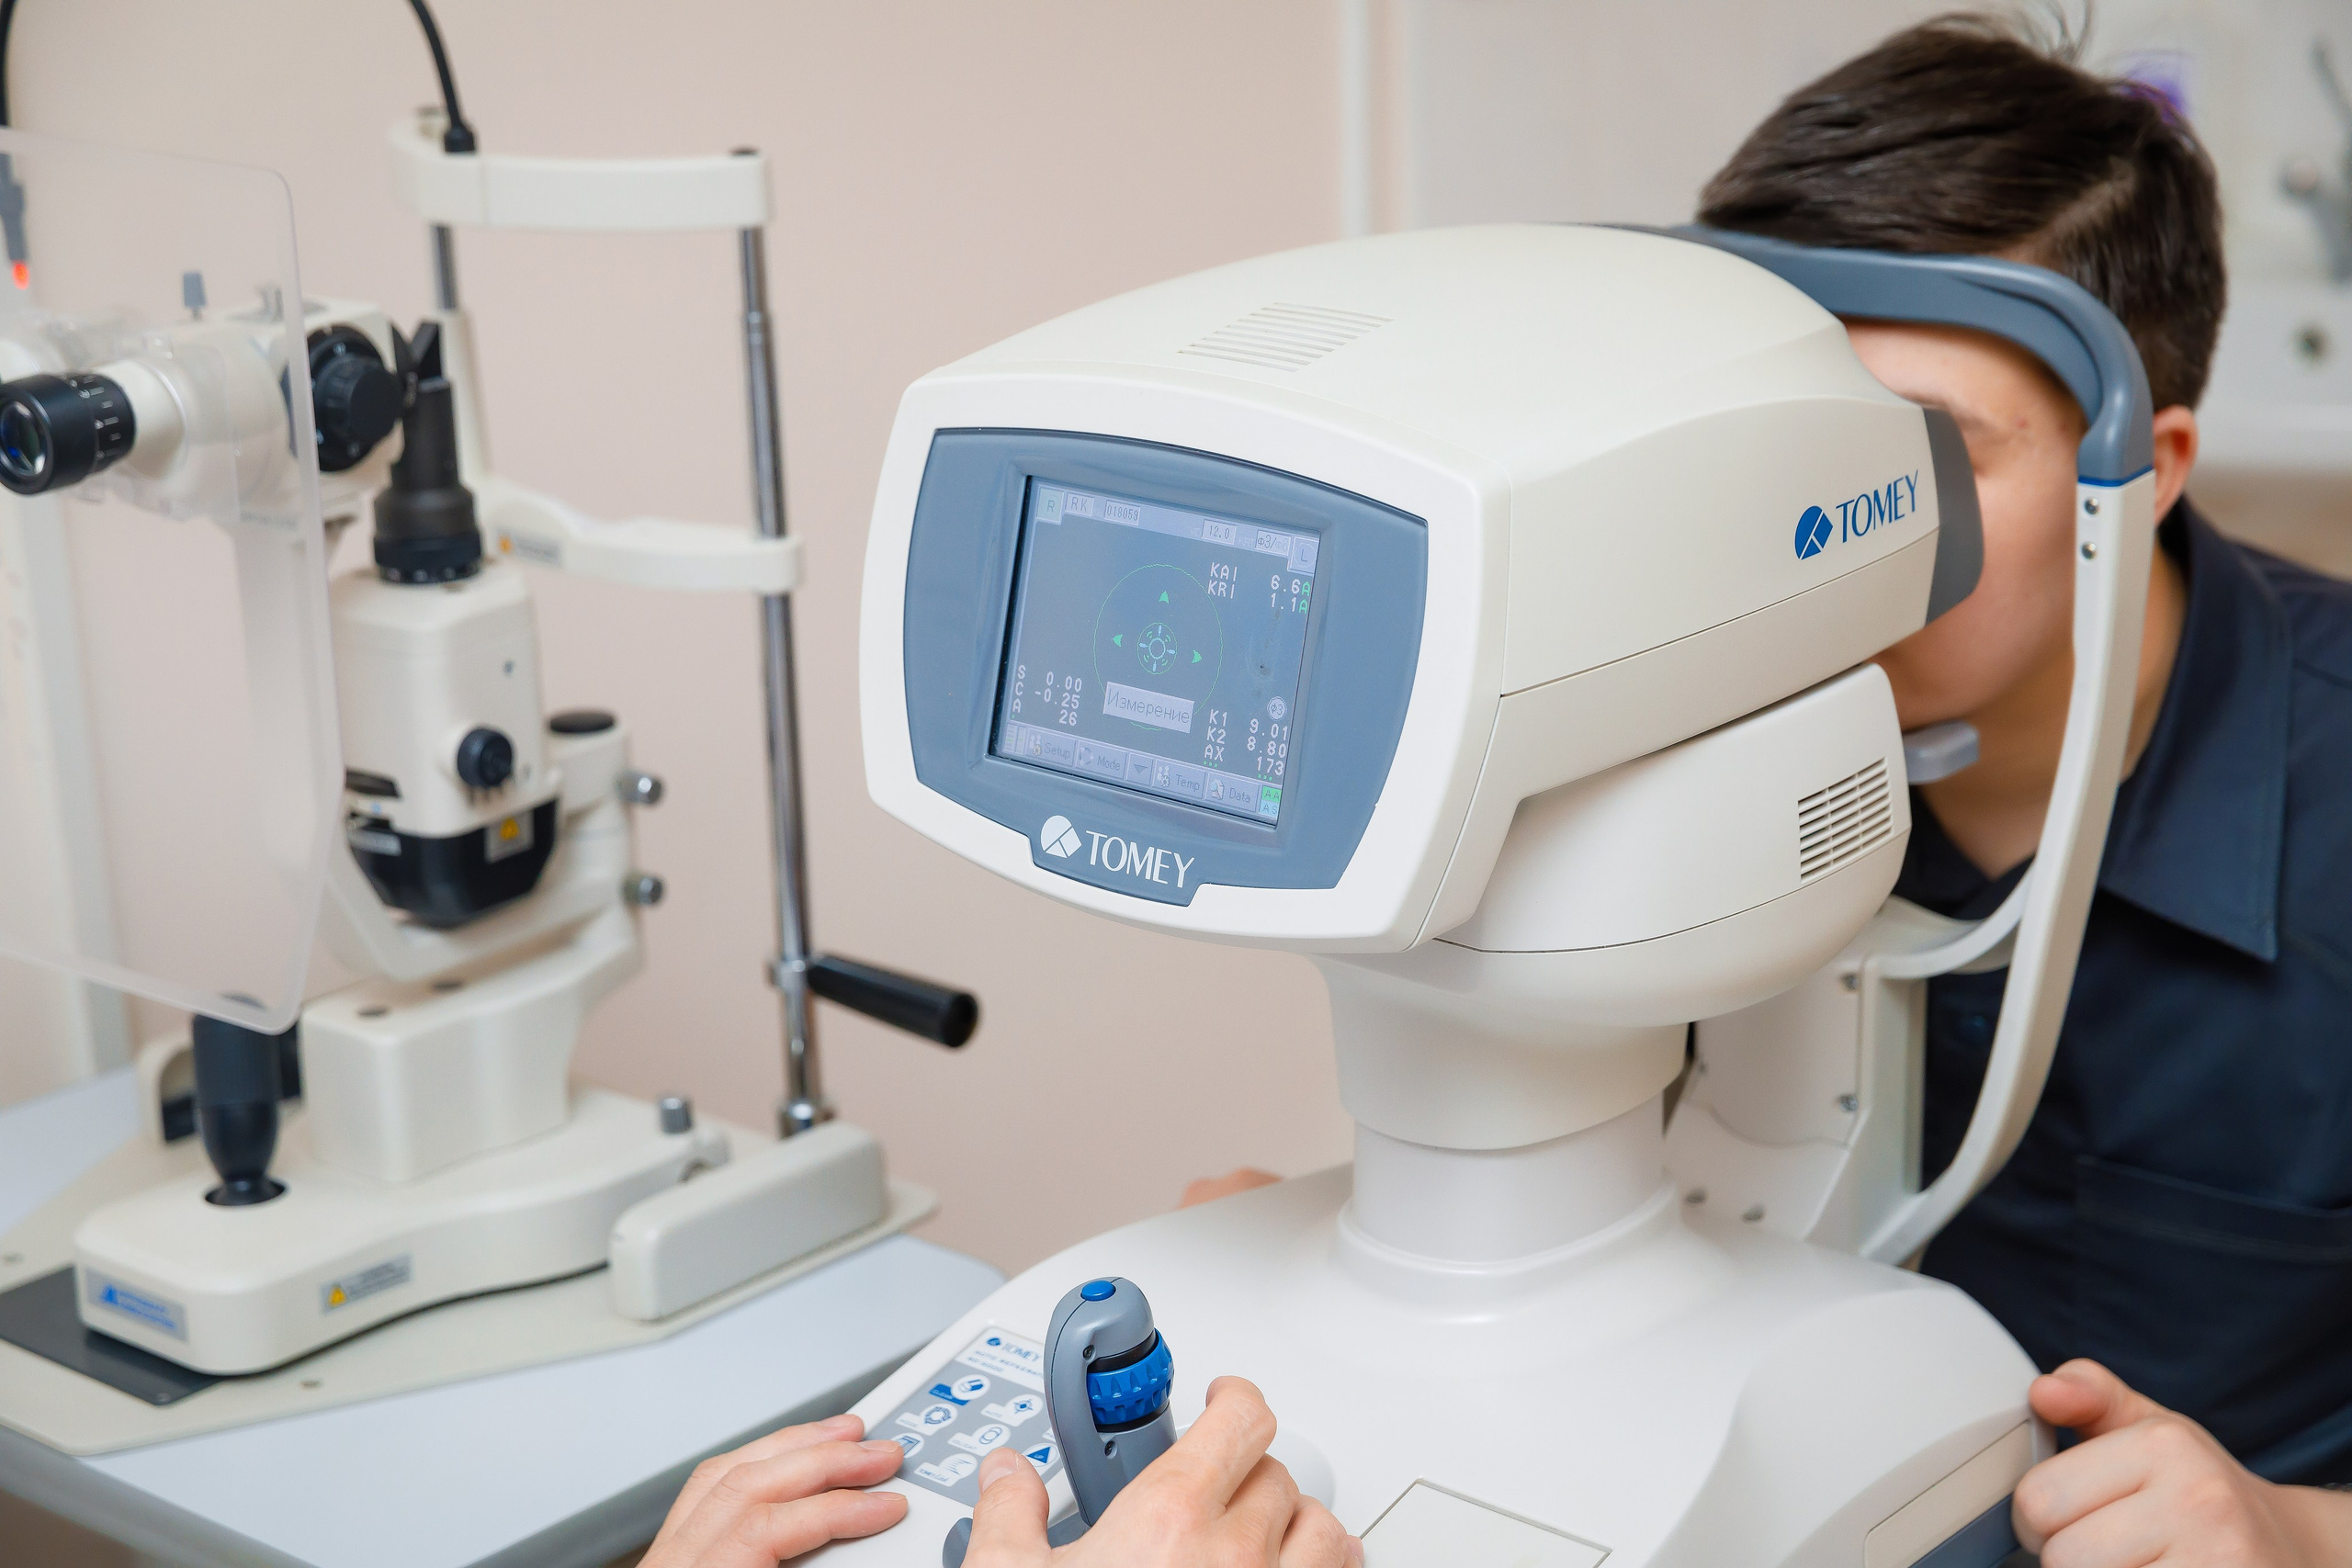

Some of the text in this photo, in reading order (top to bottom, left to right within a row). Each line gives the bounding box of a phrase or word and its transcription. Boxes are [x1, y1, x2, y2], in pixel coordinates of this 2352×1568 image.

[1047, 500, 1056, 513] R
[1070, 496, 1088, 512] RK
[1106, 504, 1139, 522] 018059
[1836, 468, 1918, 543] TOMEY
[1208, 525, 1230, 539] 12.0
[1300, 548, 1308, 563] L
[1210, 561, 1238, 582] KAI
[1207, 579, 1235, 600] KRI
[1017, 664, 1082, 693] S 0.00
[1014, 681, 1080, 710] C -0.25
[1107, 688, 1191, 724] Измерение
[1012, 698, 1078, 727] A 26
[1209, 708, 1288, 741] K1 9.01
[1044, 742, 1071, 761] Setup
[1206, 726, 1287, 759] K2 8.80
[1097, 755, 1121, 772] Mode
[1204, 743, 1284, 776] AX 173
[1176, 773, 1201, 793] Temp
[1229, 787, 1251, 804] Data
[1085, 829, 1195, 889] TOMEY
